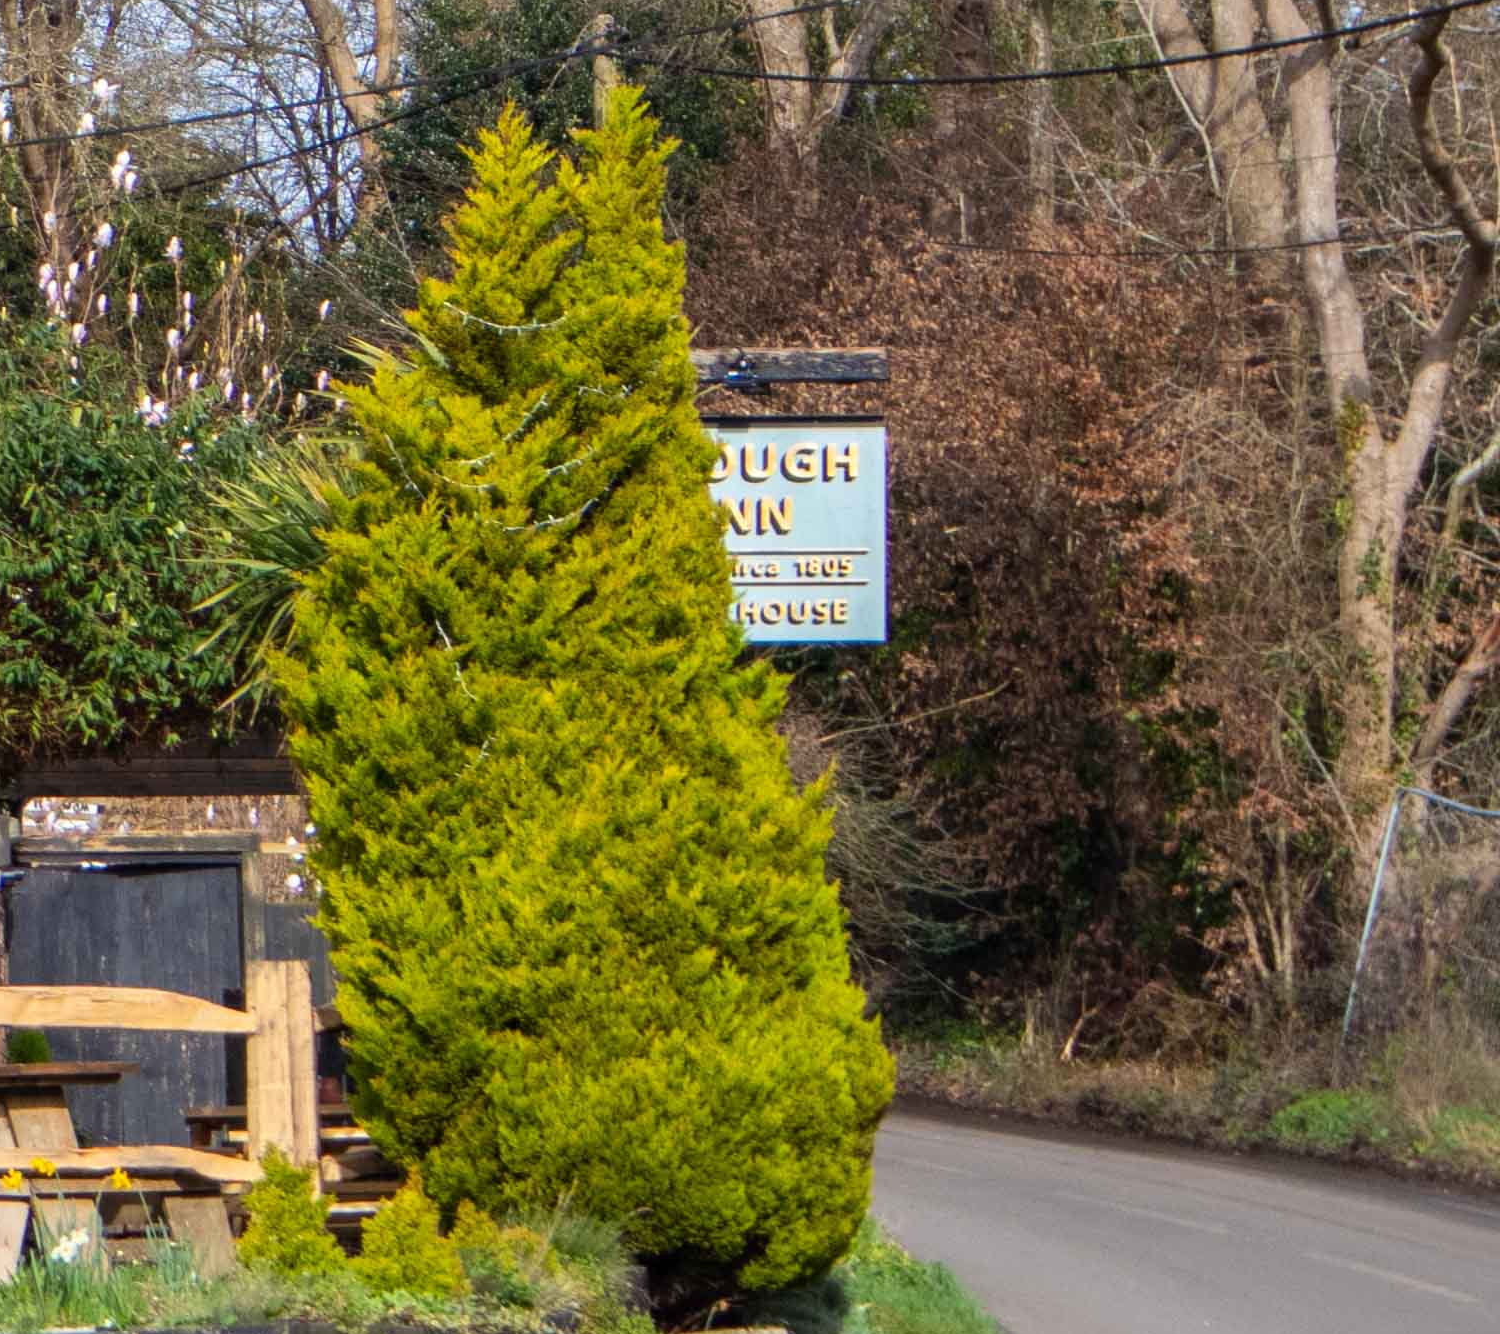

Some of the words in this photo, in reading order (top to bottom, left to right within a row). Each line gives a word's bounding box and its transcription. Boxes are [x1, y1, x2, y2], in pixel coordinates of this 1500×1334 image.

[707, 443, 860, 484] OUGH
[717, 496, 794, 536] NN
[793, 555, 854, 578] 1805
[736, 598, 849, 625] HOUSE
